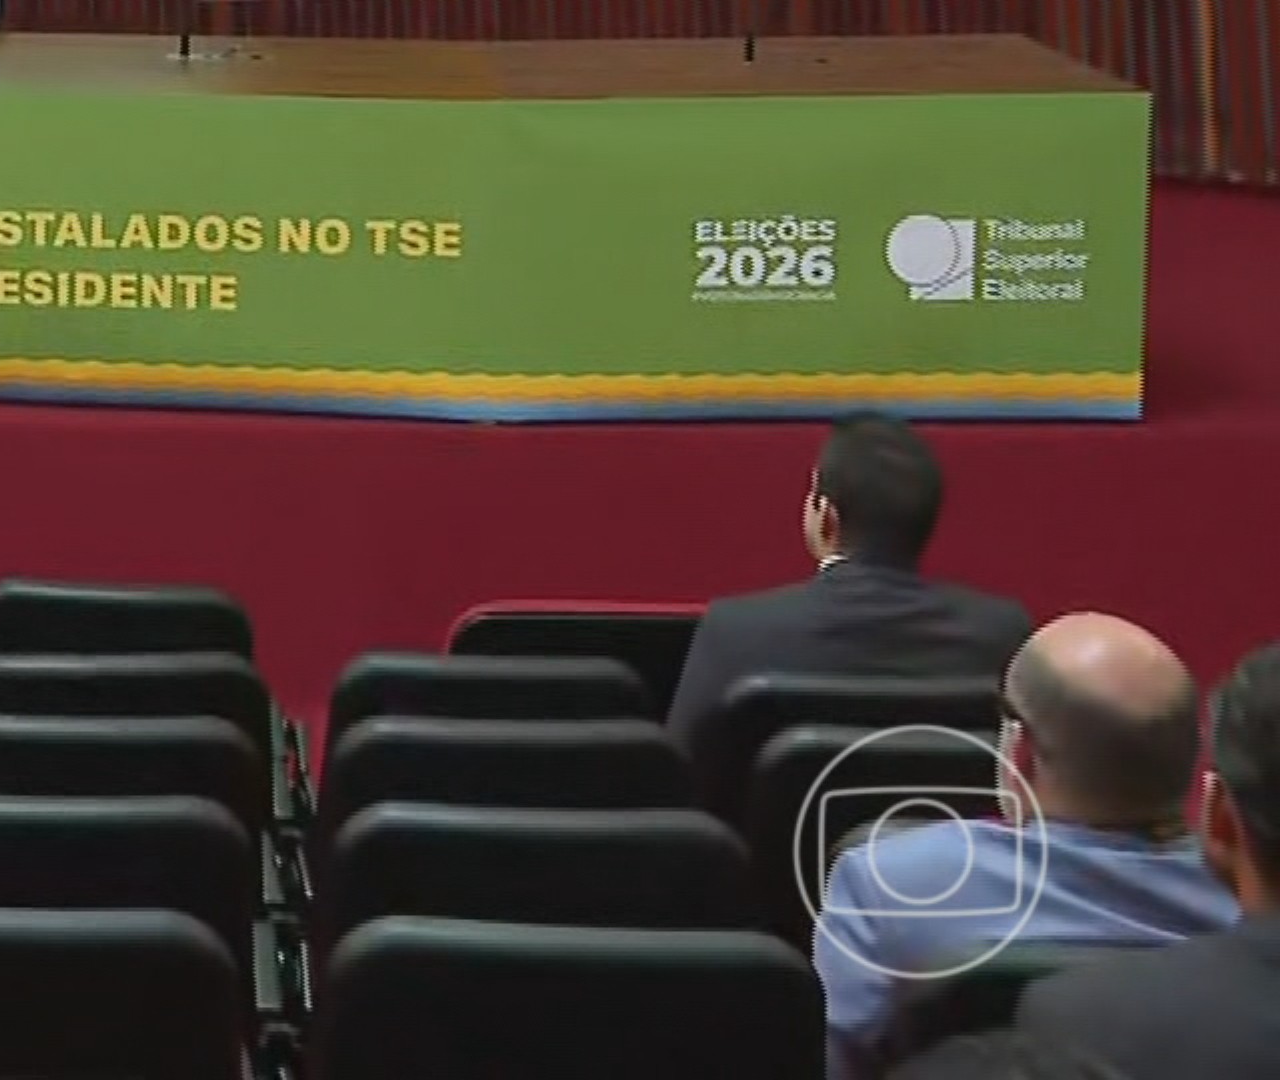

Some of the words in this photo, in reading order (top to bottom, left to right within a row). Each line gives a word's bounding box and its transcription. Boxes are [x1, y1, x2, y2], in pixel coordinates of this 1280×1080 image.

[278, 217, 352, 255] NO
[366, 220, 463, 257] TSE
[693, 215, 837, 246] ELEIÇÕES
[984, 219, 1086, 240] Tribunal
[694, 245, 837, 288] 2026
[982, 248, 1088, 273] Superior
[982, 276, 1085, 301] Eleitoral
